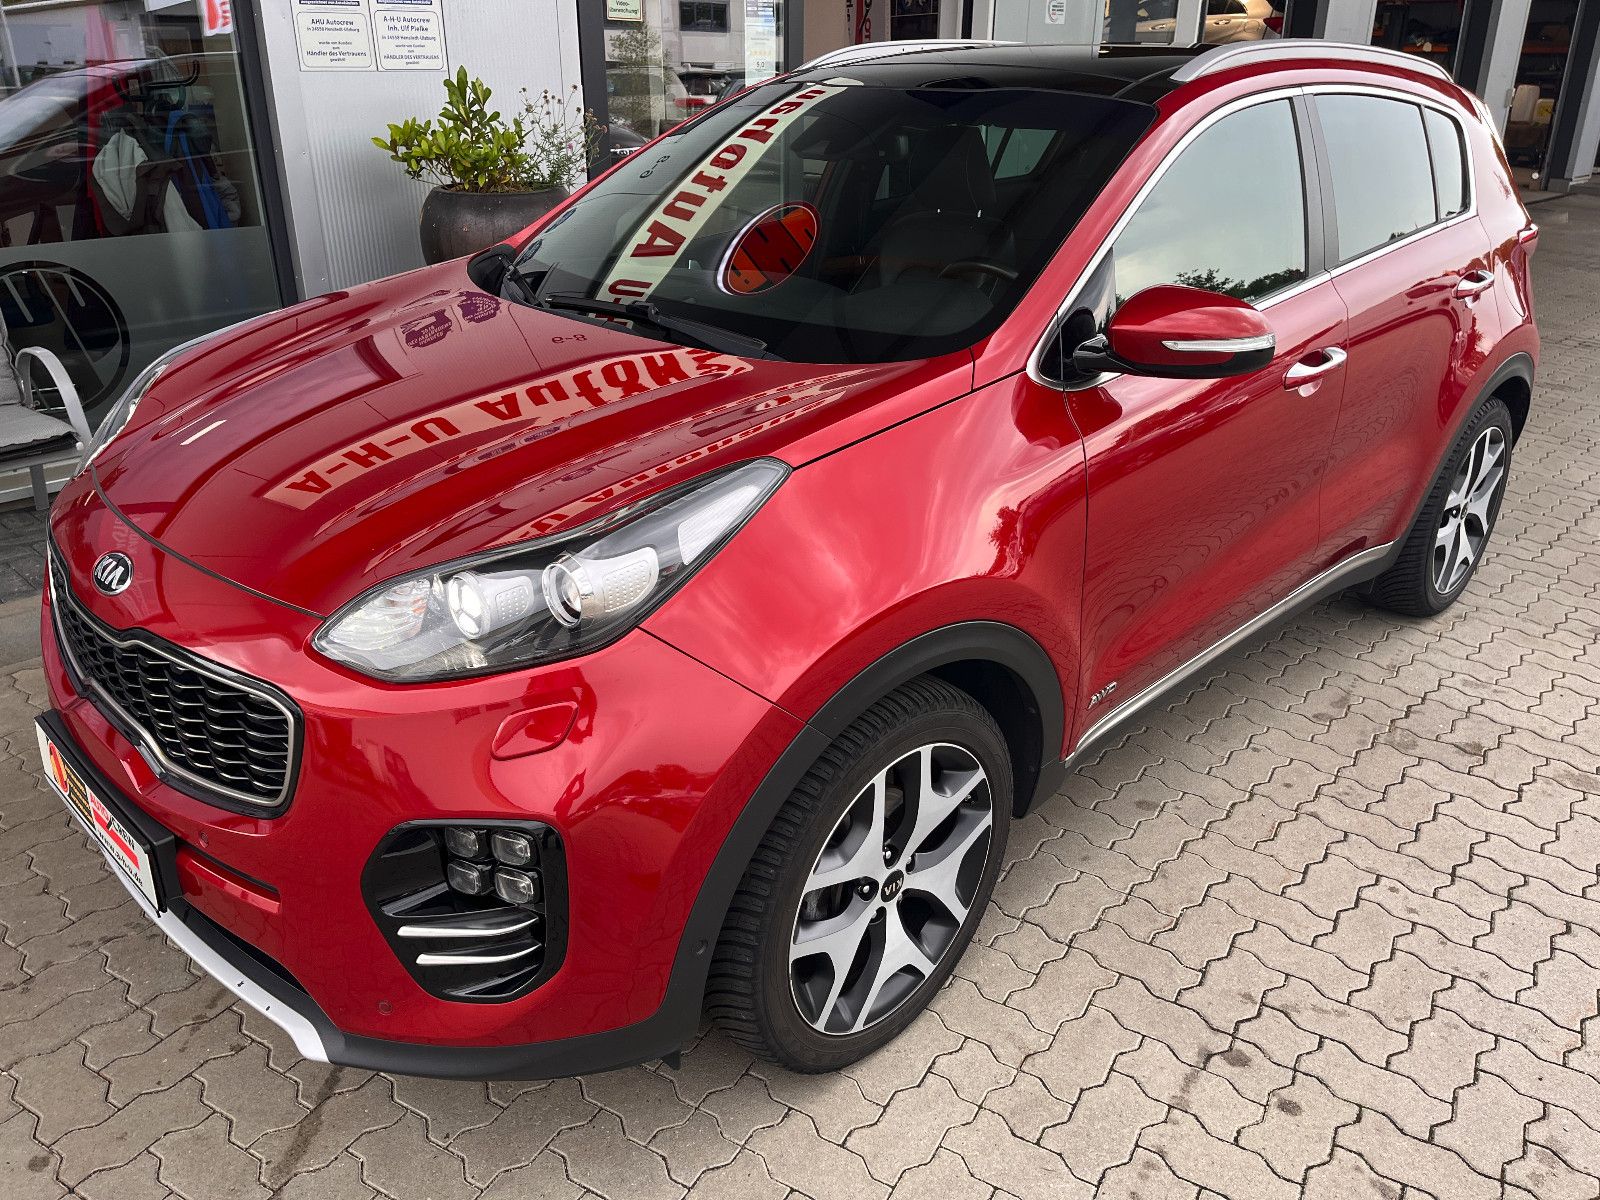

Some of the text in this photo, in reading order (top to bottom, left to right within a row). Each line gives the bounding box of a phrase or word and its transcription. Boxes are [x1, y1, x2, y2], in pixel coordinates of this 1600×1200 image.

[383, 15, 401, 23] A-H-U
[94, 555, 125, 590] KIA
[883, 877, 904, 896] KIA
